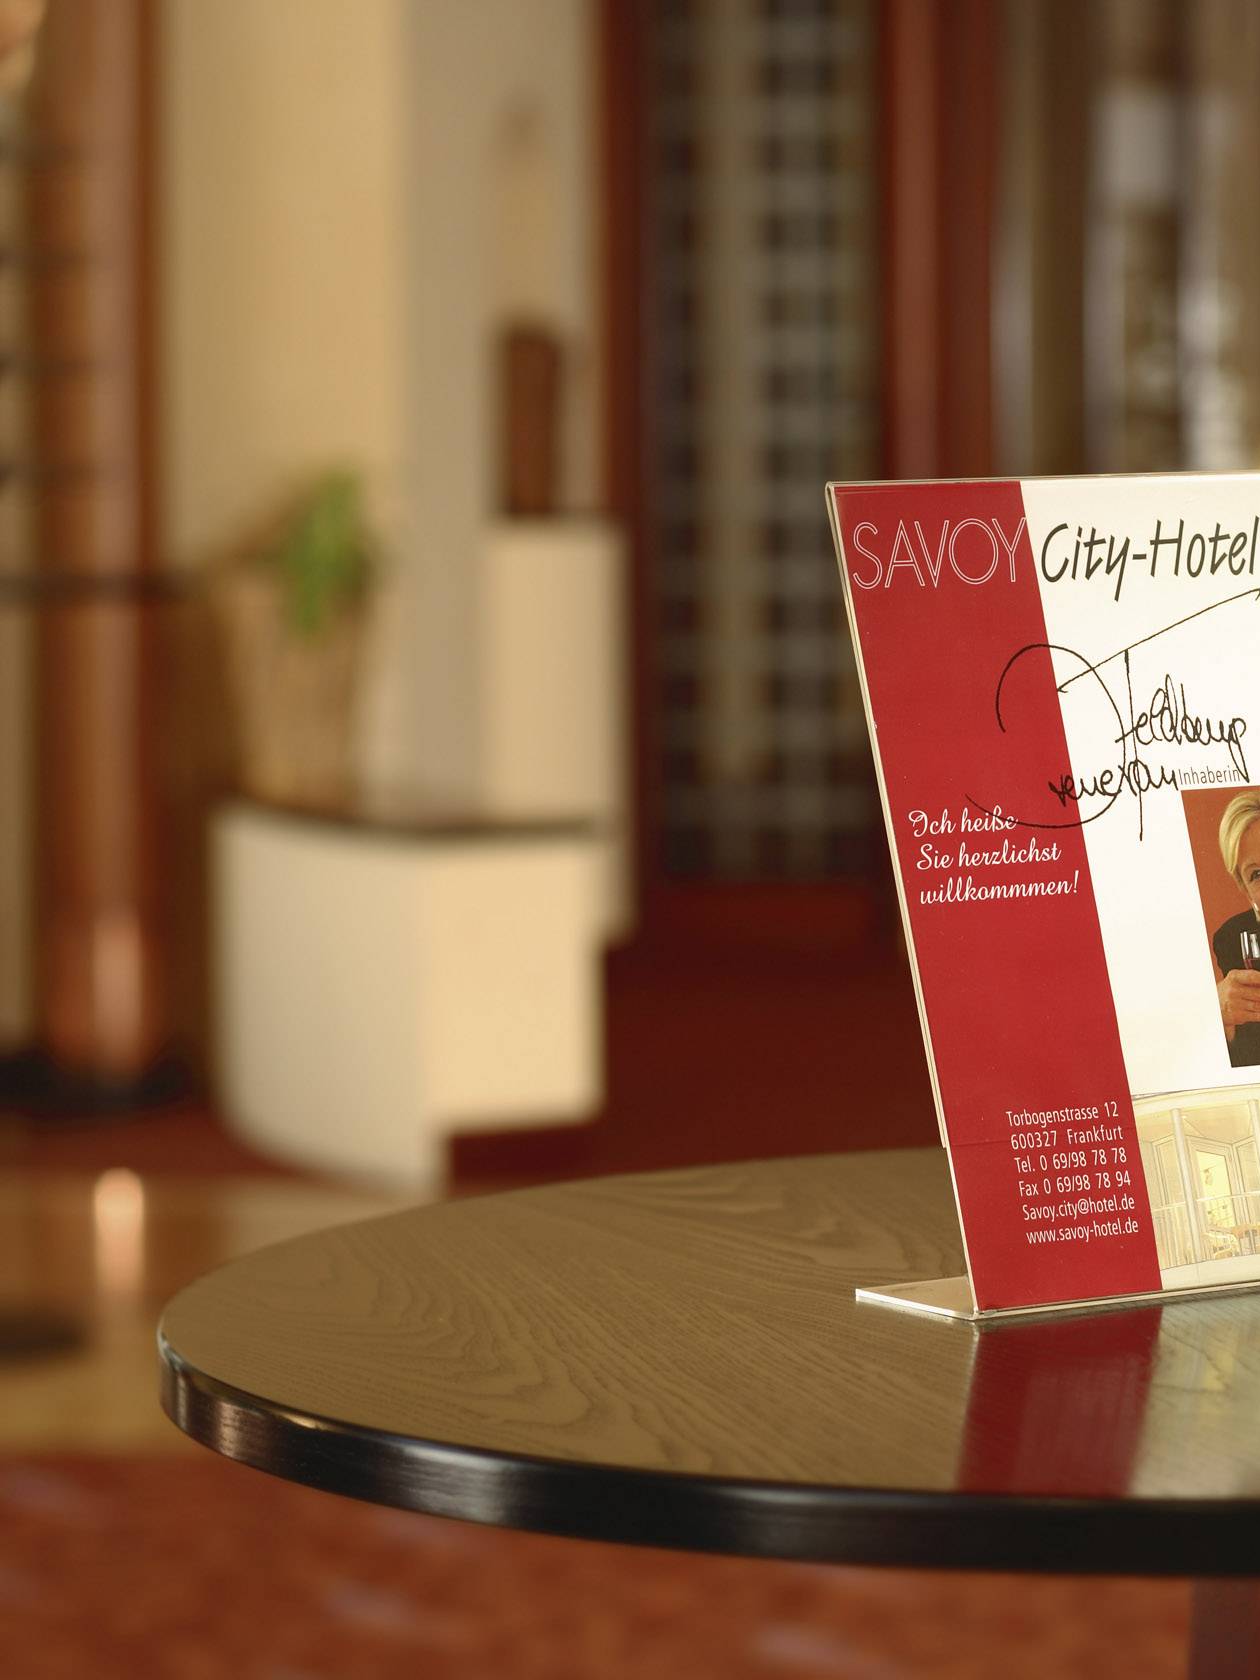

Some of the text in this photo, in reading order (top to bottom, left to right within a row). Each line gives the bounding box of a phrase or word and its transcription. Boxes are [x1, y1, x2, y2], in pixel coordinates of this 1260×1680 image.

[852, 516, 1259, 602] SAVOY City-Hotel
[1178, 765, 1241, 785] Inhaberin
[909, 805, 1018, 837] Ich heiße
[917, 837, 1062, 870] Sie herzlichst
[1006, 1101, 1119, 1128] Torbogenstrasse 12
[1011, 1125, 1123, 1150] 600327 Frankfurt
[1014, 1147, 1127, 1173] Tel. 0 69/98 78 78
[1018, 1170, 1131, 1197] Fax 0 69/98 78 94
[1022, 1193, 1135, 1222] Savoy.city@hotel.de
[1026, 1217, 1139, 1244] www.savoy-hotel.de
